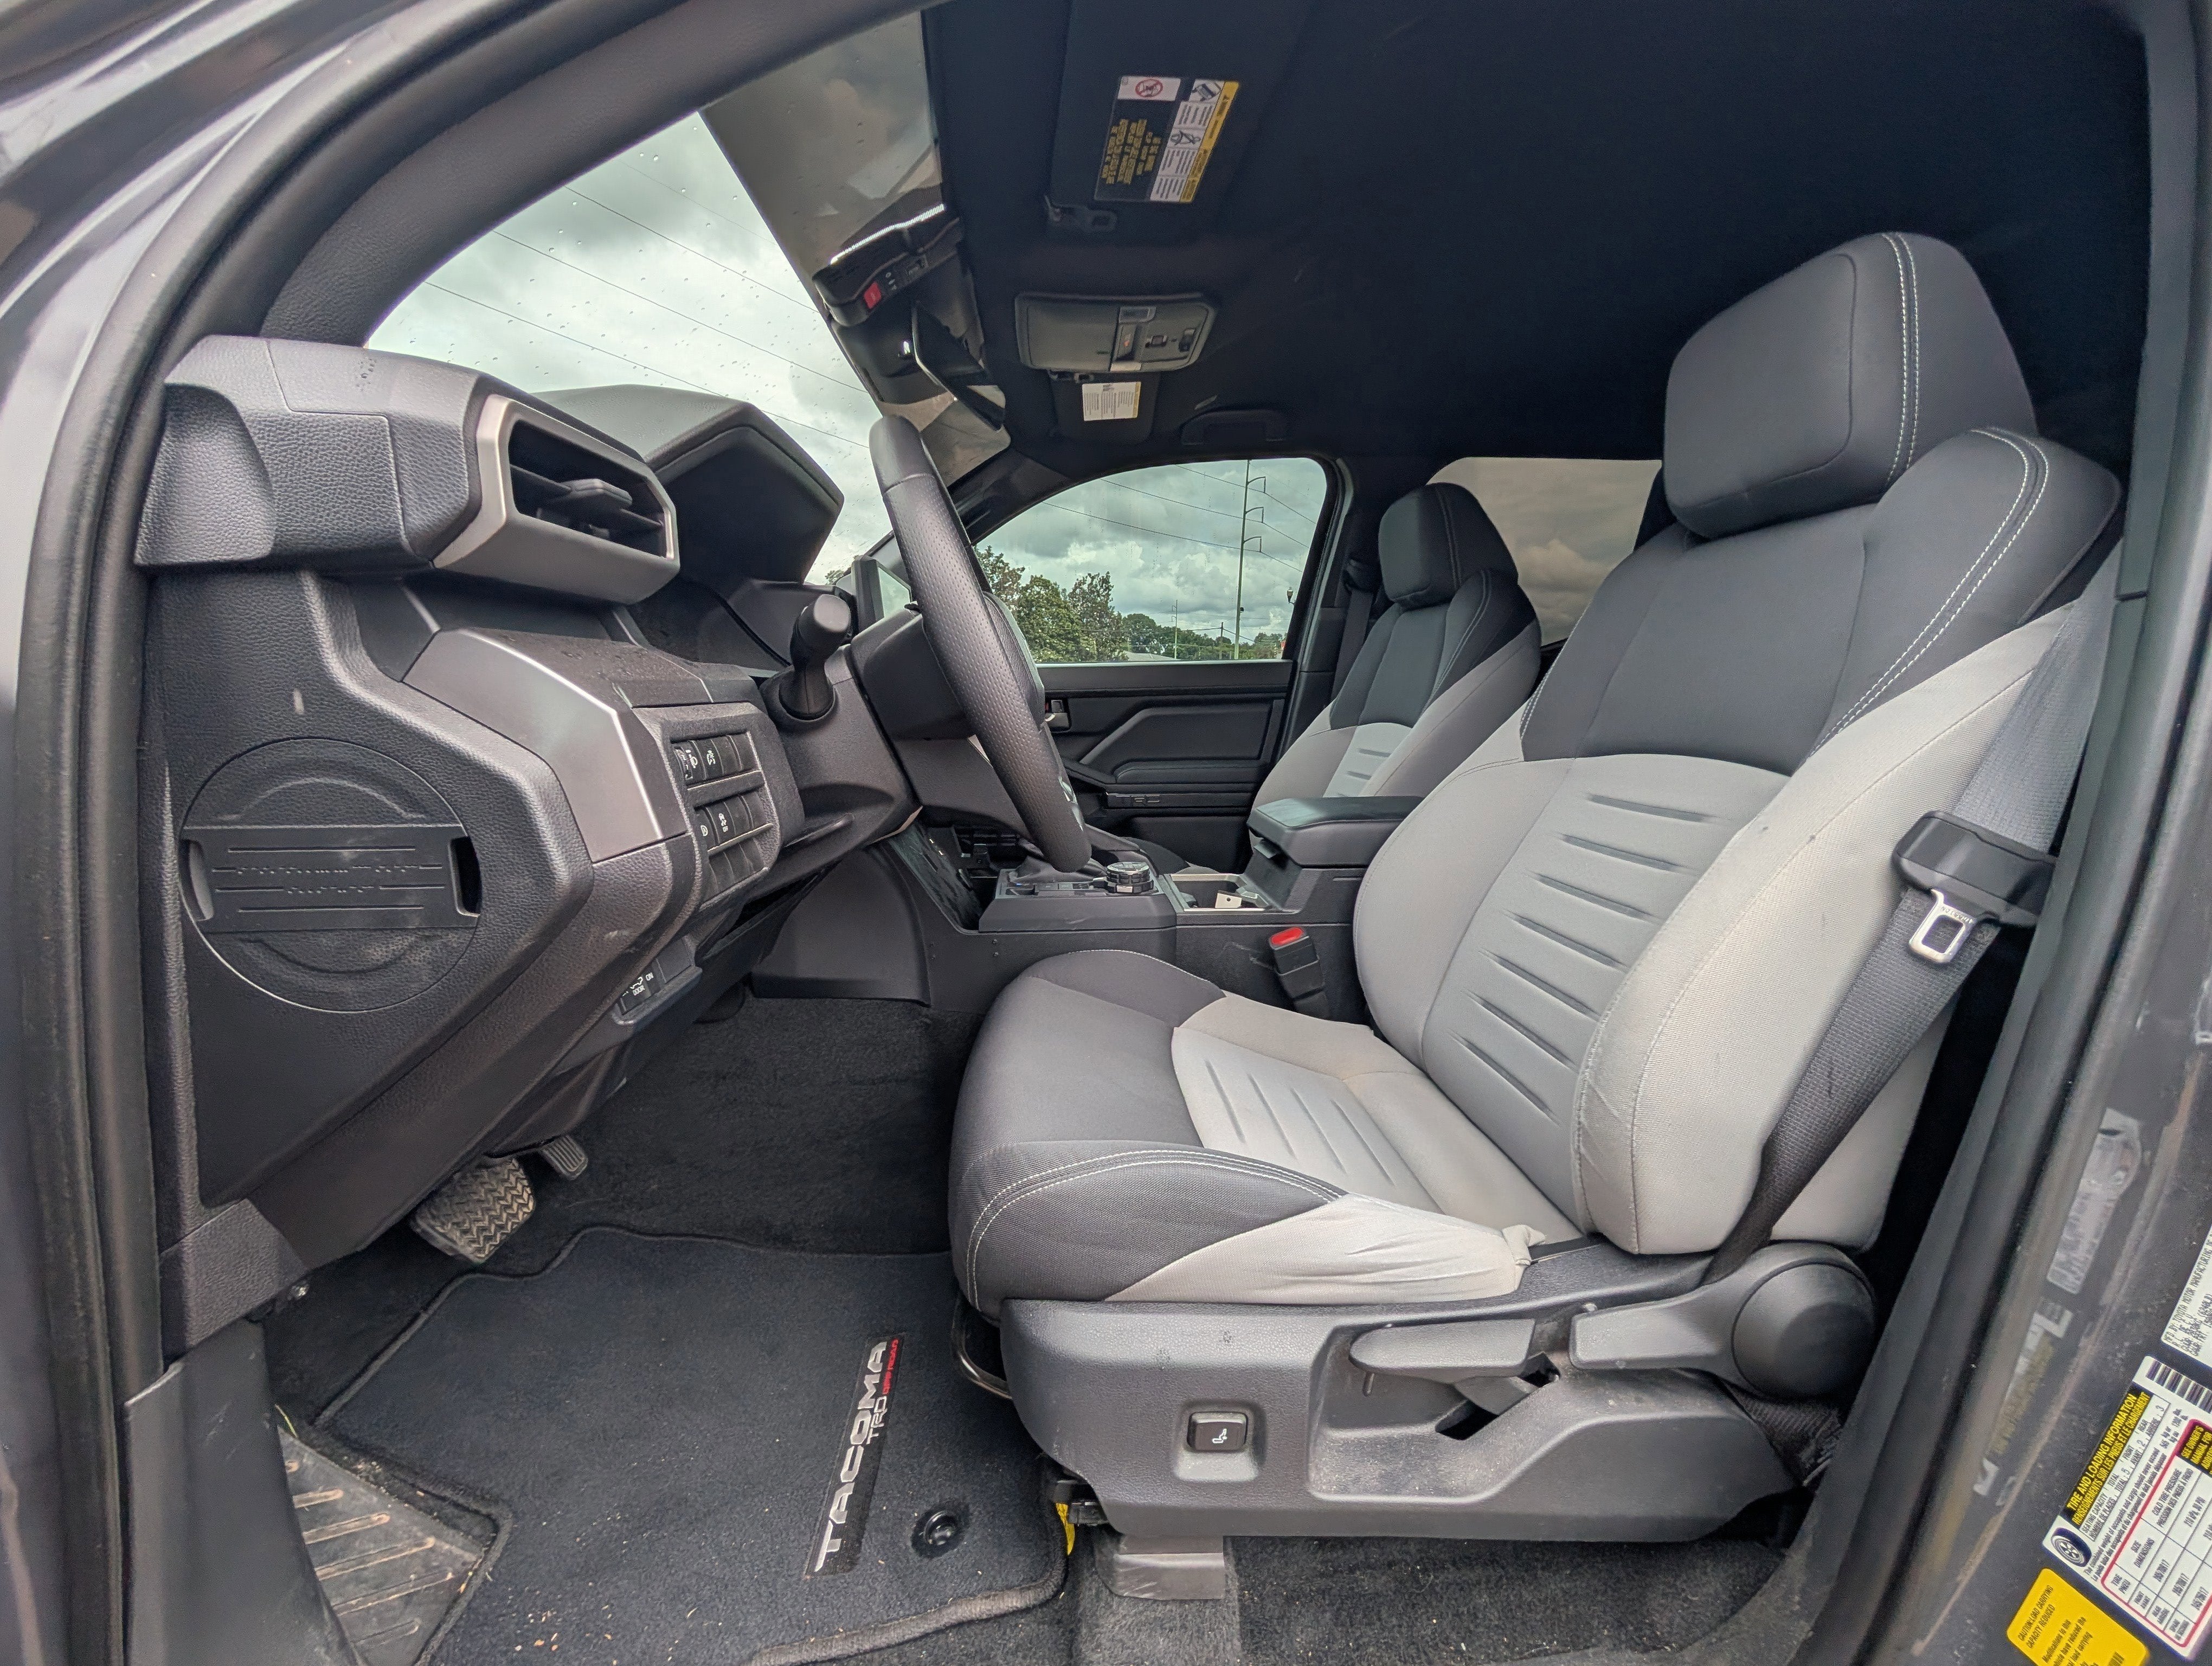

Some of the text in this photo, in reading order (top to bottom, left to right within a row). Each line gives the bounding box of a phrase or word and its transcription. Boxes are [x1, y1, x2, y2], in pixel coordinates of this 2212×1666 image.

[645, 972, 654, 981] ON
[633, 985, 645, 996] DOOR
[2155, 1404, 2165, 1412] 3
[866, 1395, 888, 1445] TRD
[2138, 1419, 2150, 1432] REAR
[2136, 1438, 2146, 1447] 2
[2180, 1424, 2204, 1459] SEE OWNER'S
[2190, 1431, 2212, 1465] MANUAL FOR
[814, 1341, 888, 1572] TACOMA
[2066, 1393, 2138, 1512] TIRE AND LOADING INFORMATION
[2071, 1392, 2151, 1526] RENSEIGNEMENTS SUR LES PNEUS ET LE CHARGEMENT
[2122, 1444, 2135, 1460] FRONT
[2147, 1447, 2160, 1464] exceed
[2120, 1466, 2130, 1475] 5
[2140, 1462, 2152, 1477] never
[2181, 1466, 2194, 1482] FROID
[2107, 1472, 2119, 1487] TOTAL
[2133, 1475, 2144, 1489] should
[2126, 1488, 2138, 1502] cargo
[2151, 1467, 2182, 1516] COLD TIRE PRESSURE
[2171, 1483, 2185, 1500] PNEUS
[2121, 1498, 2131, 1509] and
[2166, 1497, 2178, 1508] DES
[2081, 1492, 2108, 1534] SEATING CAPACITY
[2088, 1496, 2115, 1539] NOMBRE DE PLACES
[2110, 1507, 2127, 1531] occupants
[2156, 1505, 2174, 1528] PRESSION
[2093, 1563, 2105, 1577] poids
[2105, 1547, 2113, 1557] des
[2109, 1528, 2125, 1550] occupants
[2126, 1496, 2144, 1521] chargement
[2099, 1533, 2112, 1549] weight
[2130, 1540, 2142, 1553] SIZE
[2133, 1537, 2155, 1568] DIMENSIONS
[2088, 1546, 2104, 1568] combined
[2084, 1566, 2093, 1576] The
[2111, 1573, 2123, 1587] TIRE
[2118, 1578, 2131, 1594] PNEU
[2035, 1584, 2054, 1610] CARRYING
[2025, 1603, 2055, 1649] CAPACITY REDUCED
[2042, 1617, 2071, 1663] Modifications to this
[2060, 1641, 2072, 1656] have
[2066, 1623, 2081, 1644] reduced
[2076, 1614, 2086, 1626] the
[2076, 1630, 2093, 1654] carrying
